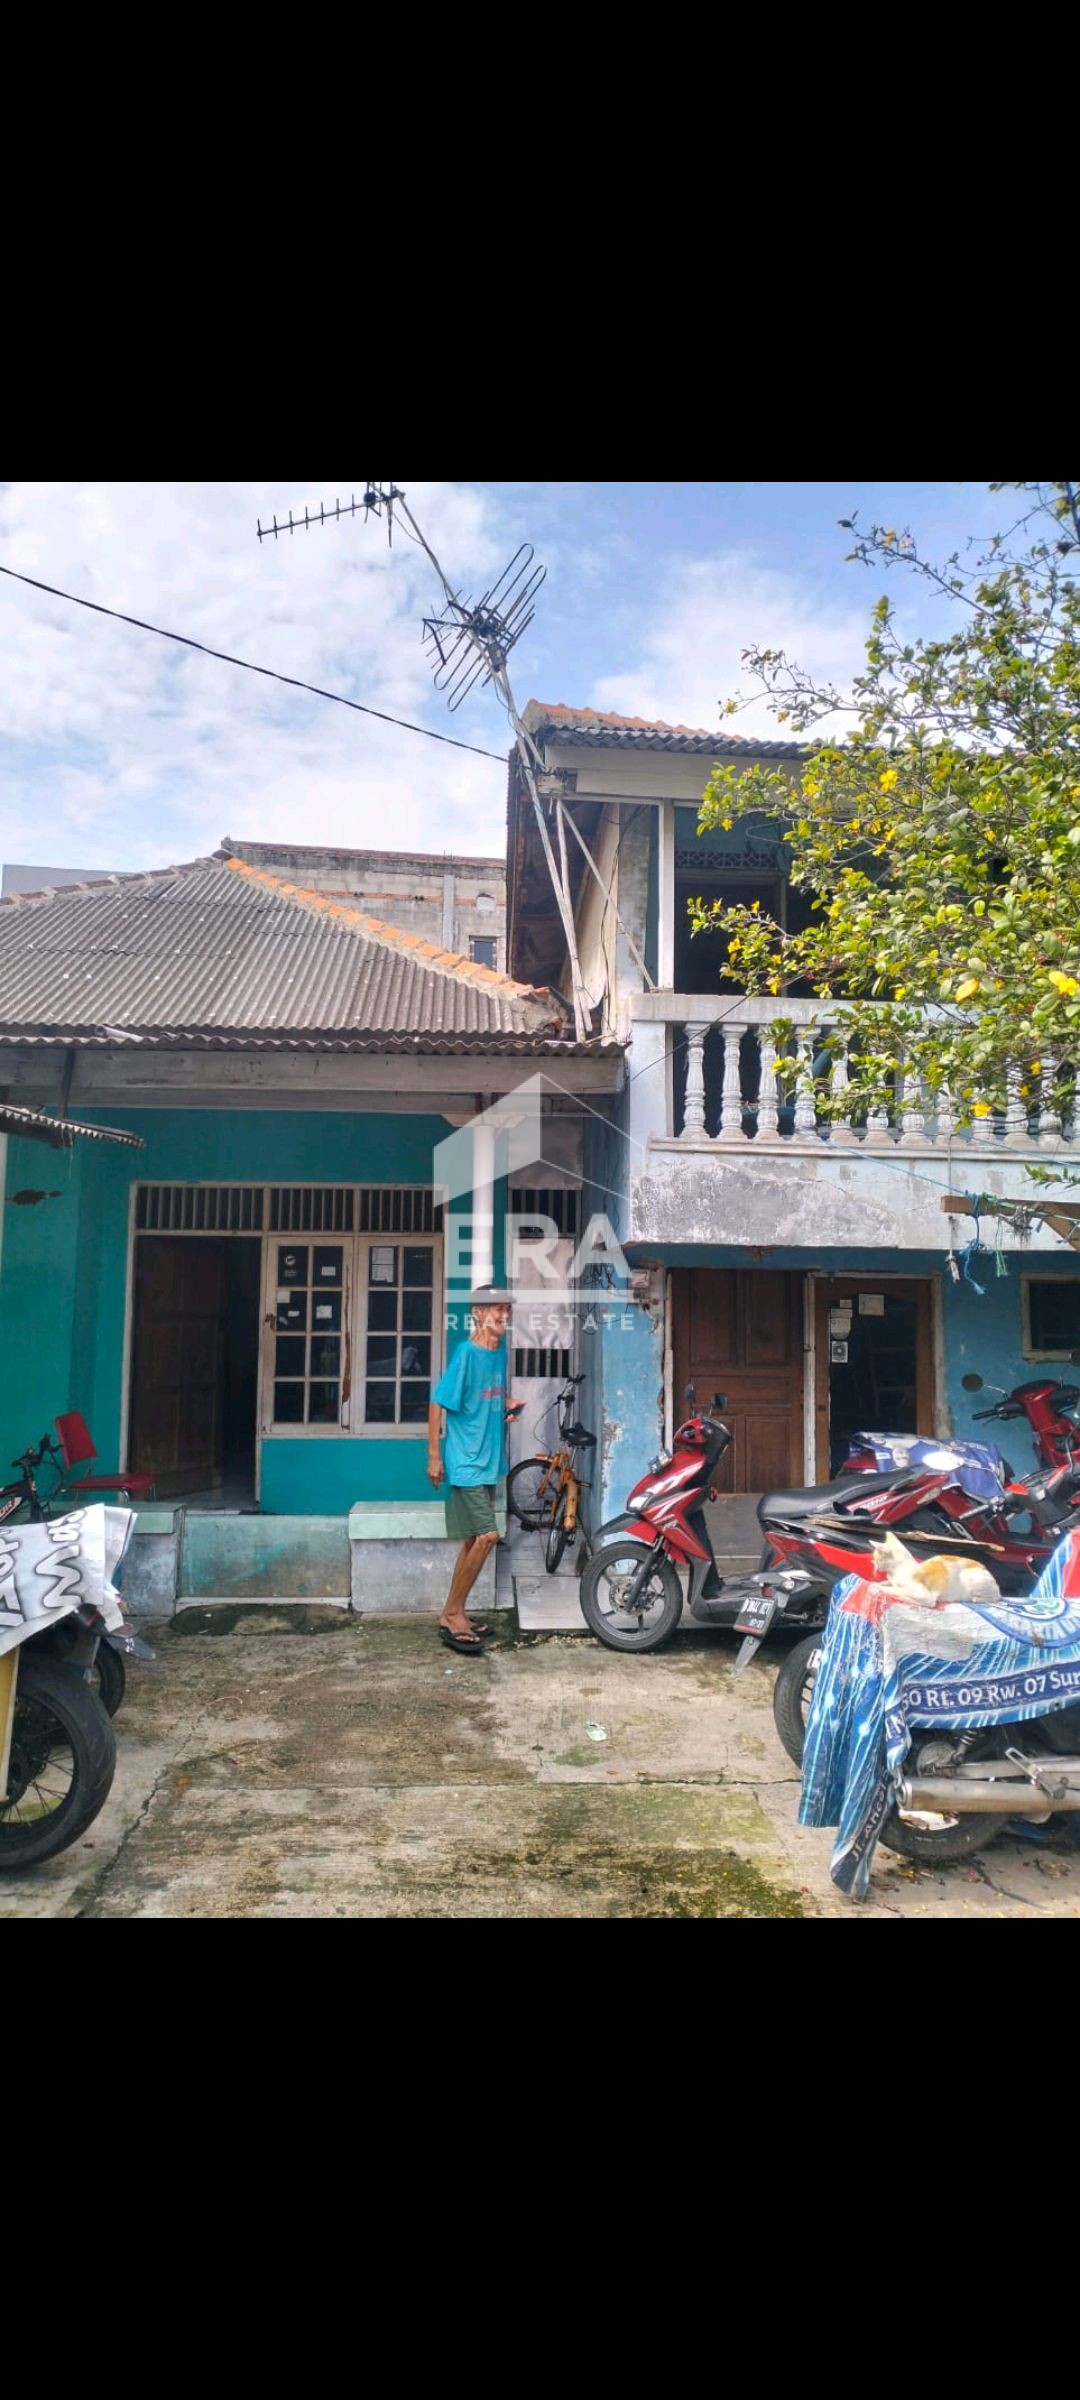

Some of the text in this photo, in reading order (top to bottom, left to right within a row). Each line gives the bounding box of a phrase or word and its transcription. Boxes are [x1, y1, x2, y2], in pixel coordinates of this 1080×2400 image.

[926, 1688, 955, 1708] Rt.
[957, 1687, 983, 1706] 09
[988, 1684, 1021, 1703] Rw.
[1024, 1677, 1047, 1695] 07
